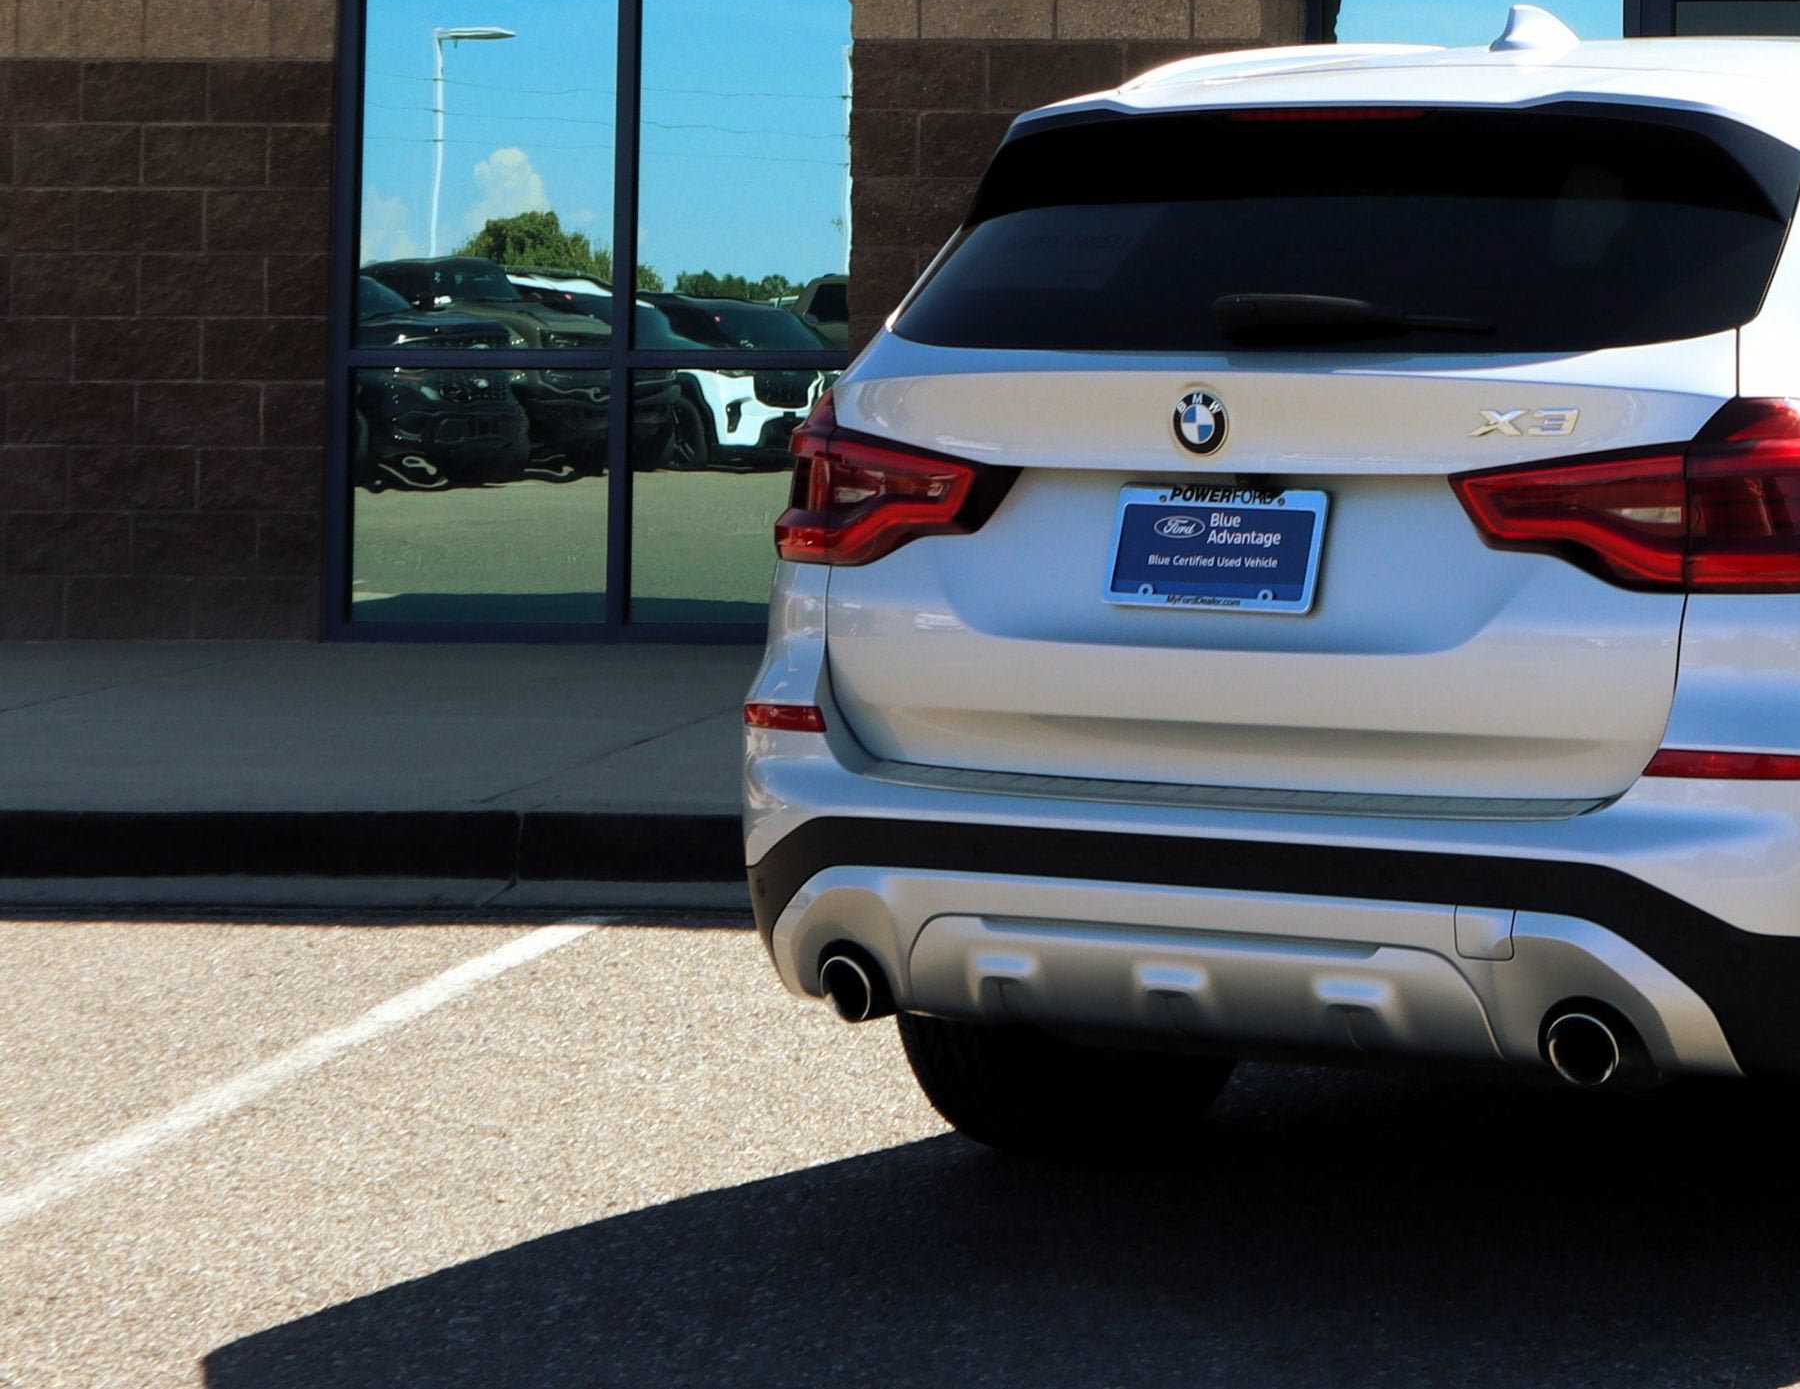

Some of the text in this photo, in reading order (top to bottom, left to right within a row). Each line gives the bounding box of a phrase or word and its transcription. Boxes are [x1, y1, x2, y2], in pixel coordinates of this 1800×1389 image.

[1177, 393, 1222, 414] BMW
[1467, 407, 1580, 437] X3
[1163, 519, 1196, 534] Ford
[1209, 513, 1241, 528] Blue
[1207, 530, 1281, 548] Advantage
[1148, 554, 1278, 568] Blue Certified Used Vehicle
